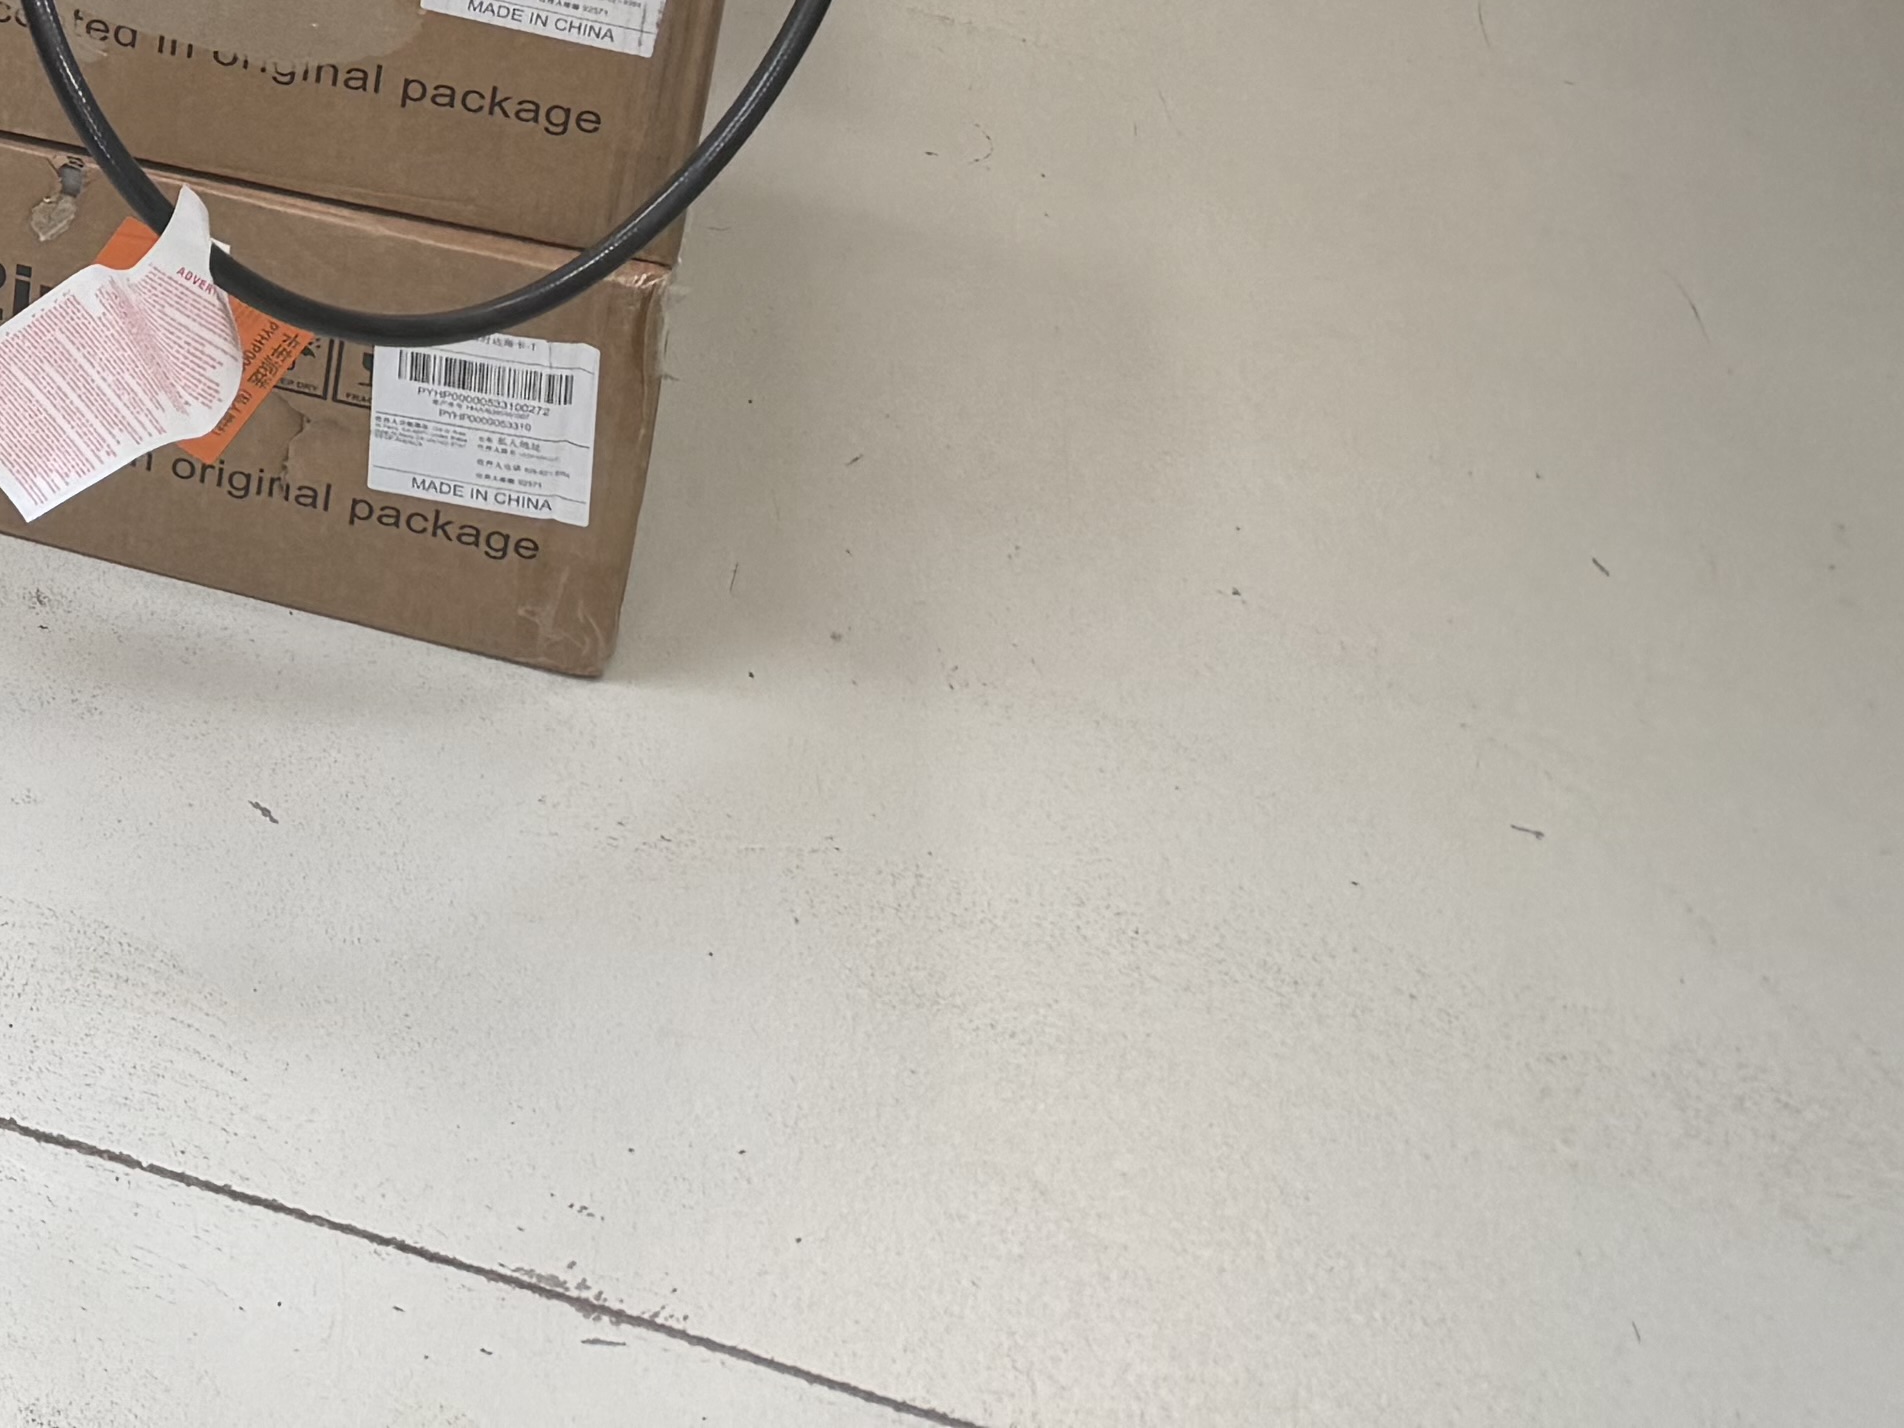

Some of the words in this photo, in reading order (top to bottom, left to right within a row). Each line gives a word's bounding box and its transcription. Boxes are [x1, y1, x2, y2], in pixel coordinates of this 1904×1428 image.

[529, 11, 549, 28] IN
[554, 18, 615, 43] CHINA
[401, 72, 603, 137] package
[170, 450, 334, 515] original
[348, 495, 541, 562] package
[410, 475, 465, 499] MADE
[469, 487, 489, 502] IN
[493, 491, 553, 512] CHINA
